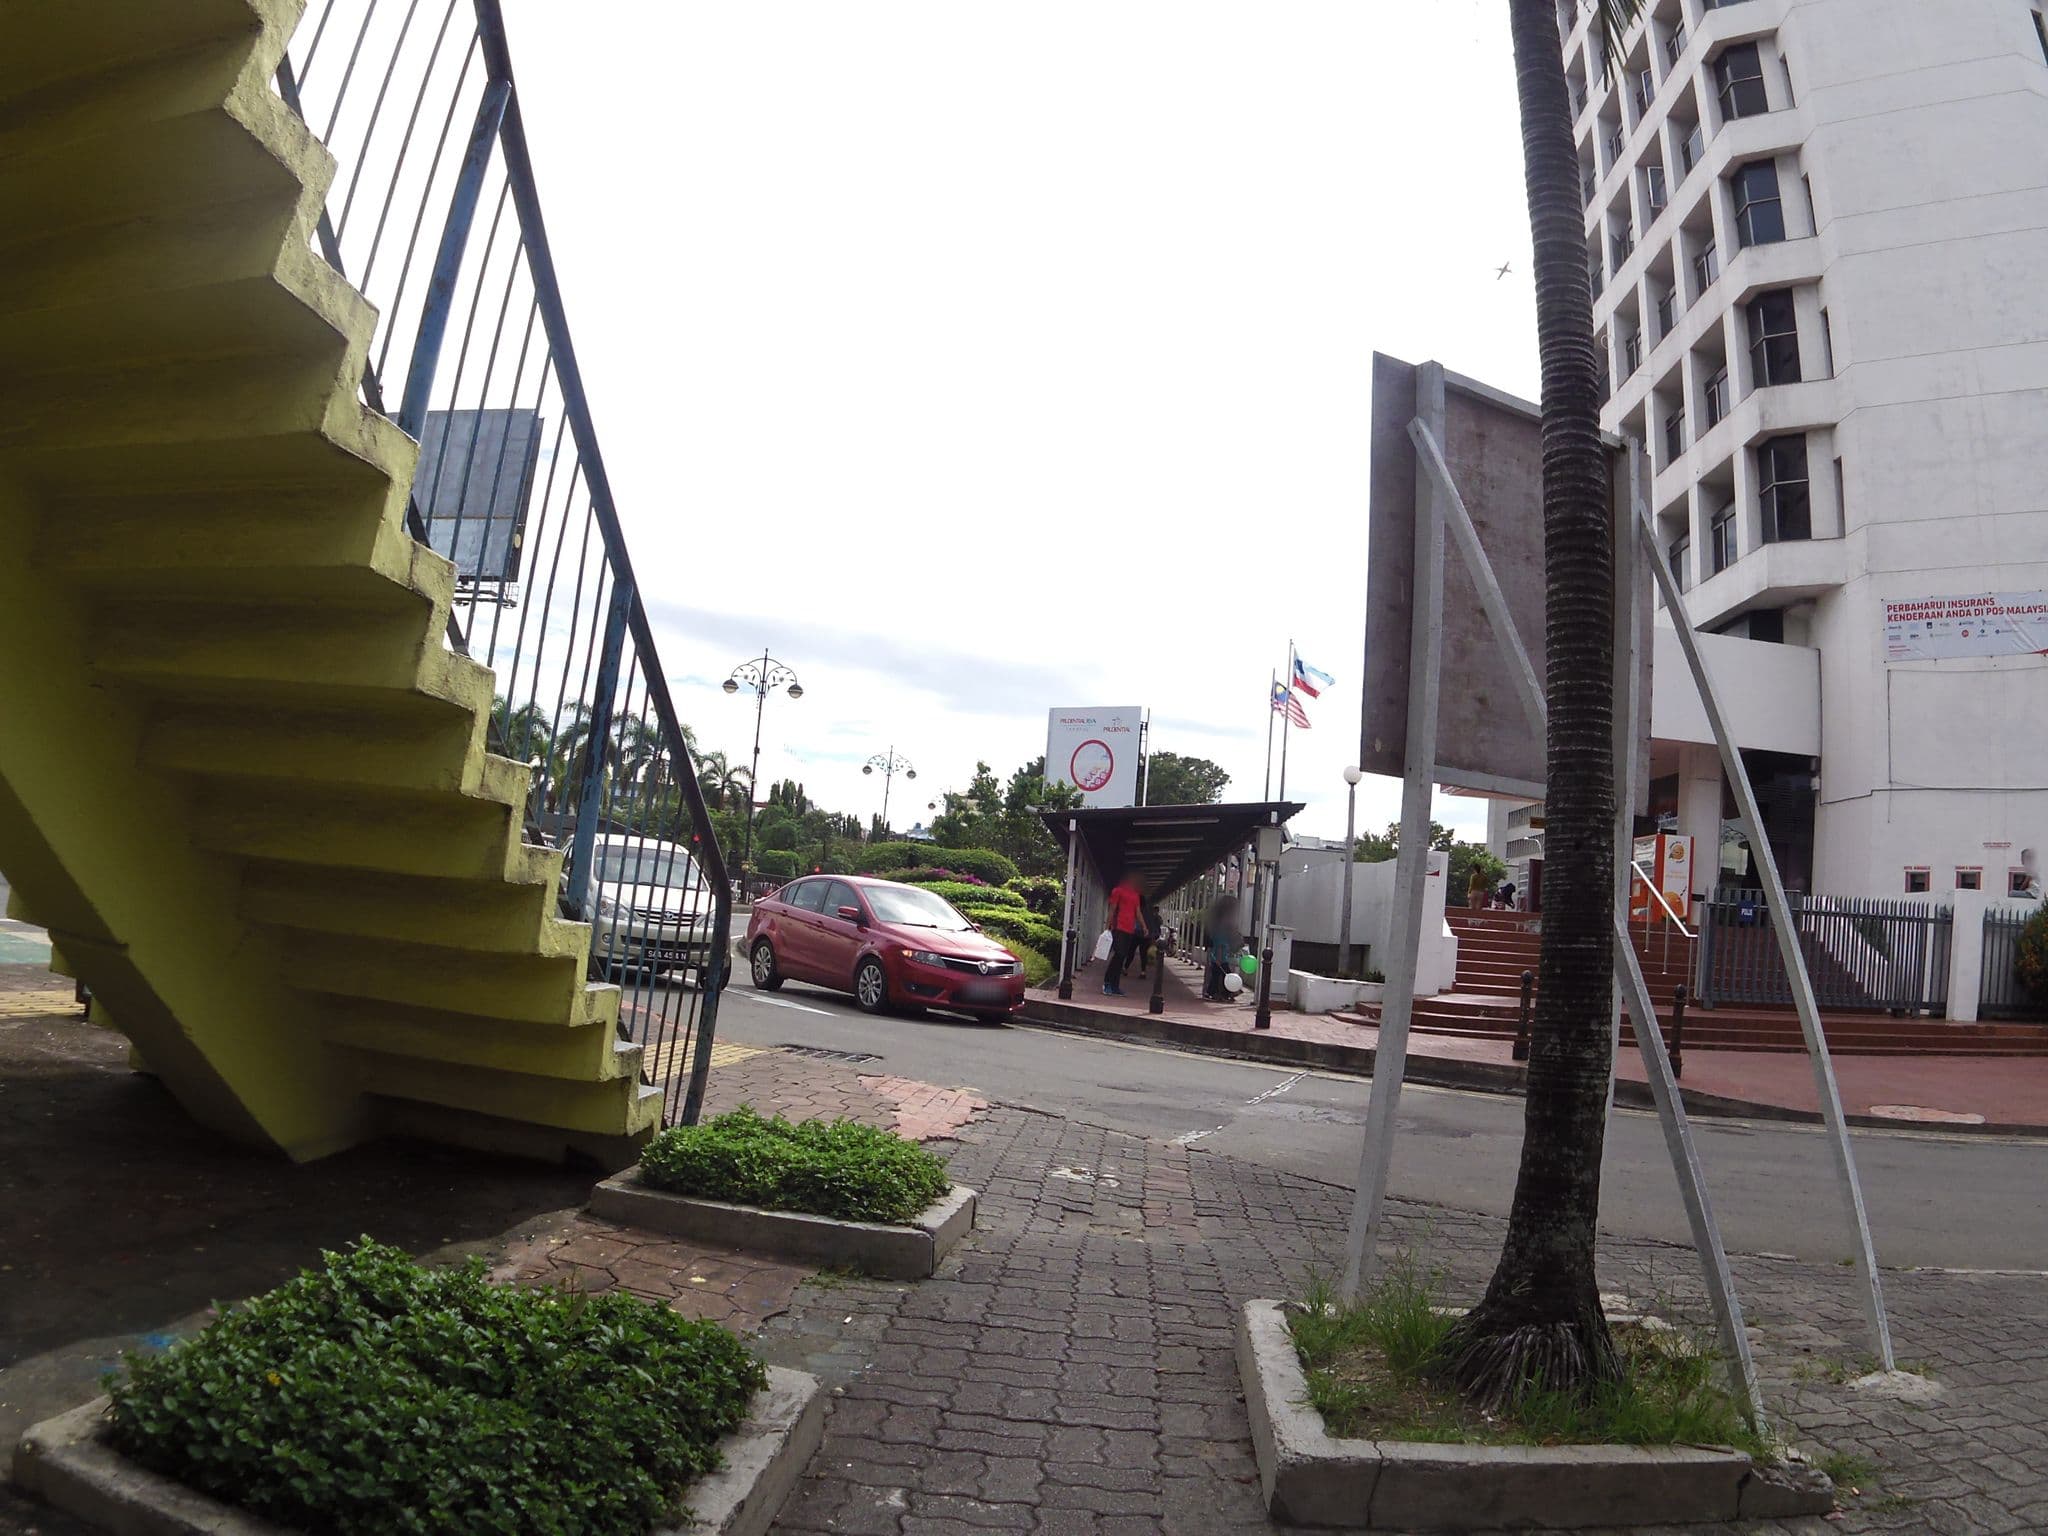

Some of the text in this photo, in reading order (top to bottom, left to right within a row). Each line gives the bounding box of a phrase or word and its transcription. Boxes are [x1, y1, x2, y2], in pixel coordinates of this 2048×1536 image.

[1887, 597, 1995, 613] PERBAHARUI INSURANS
[1887, 604, 2048, 623] KENDERAAN ANDA DI POS MALAYSI
